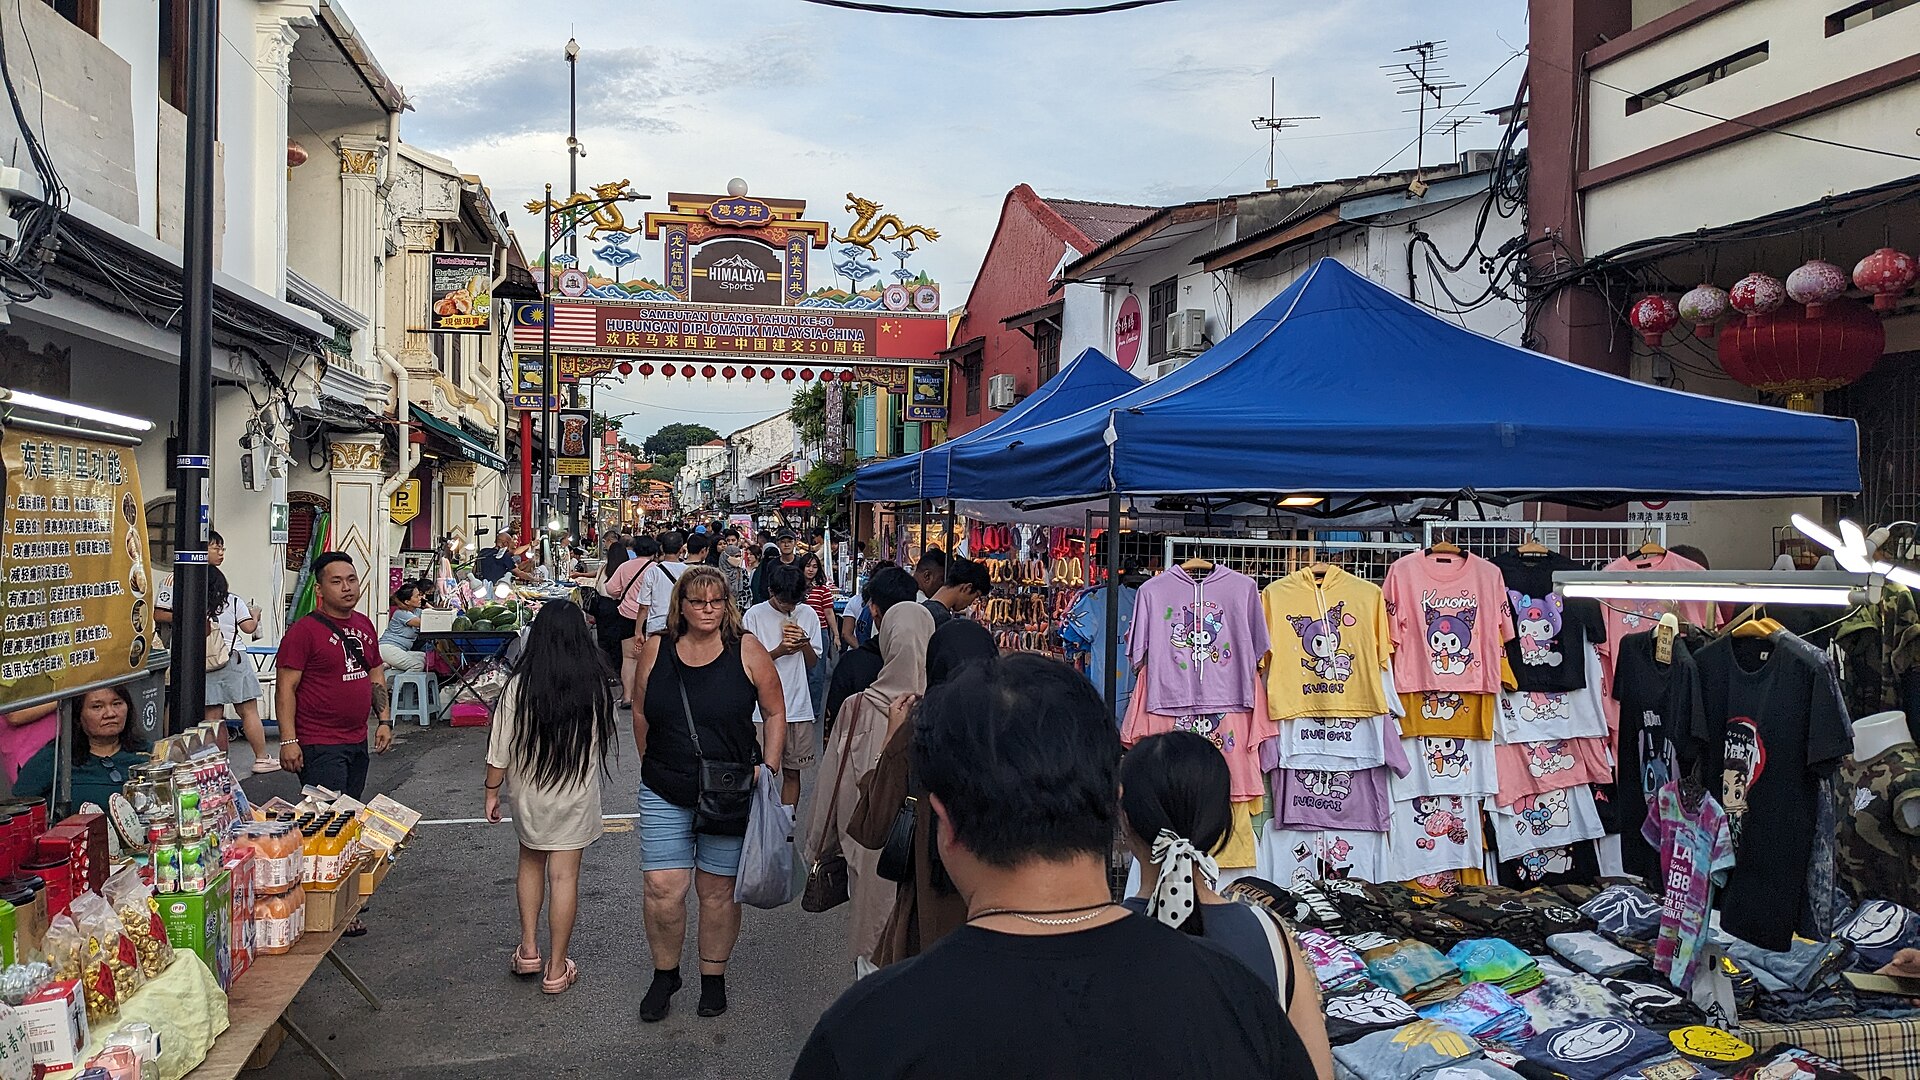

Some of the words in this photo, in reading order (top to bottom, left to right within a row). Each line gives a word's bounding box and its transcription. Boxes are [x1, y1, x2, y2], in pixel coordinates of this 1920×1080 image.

[718, 204, 762, 217] 鸡场街
[709, 267, 766, 283] HIMALAYA
[789, 242, 803, 293] 美美与共
[719, 282, 754, 293] Sports
[640, 309, 708, 321] SAMBUTAN
[712, 312, 753, 323] ULANG
[756, 314, 797, 325] TAHUN
[800, 316, 834, 327] KE-50
[606, 319, 679, 334] HUBUNGAN
[682, 323, 760, 337] DIPLOMATIK
[762, 326, 866, 341] MALAYSIA-CHINA
[913, 407, 930, 416] G.L.
[396, 491, 409, 507] P
[1421, 589, 1478, 611] Kuromi
[1301, 729, 1352, 742] KUROMI
